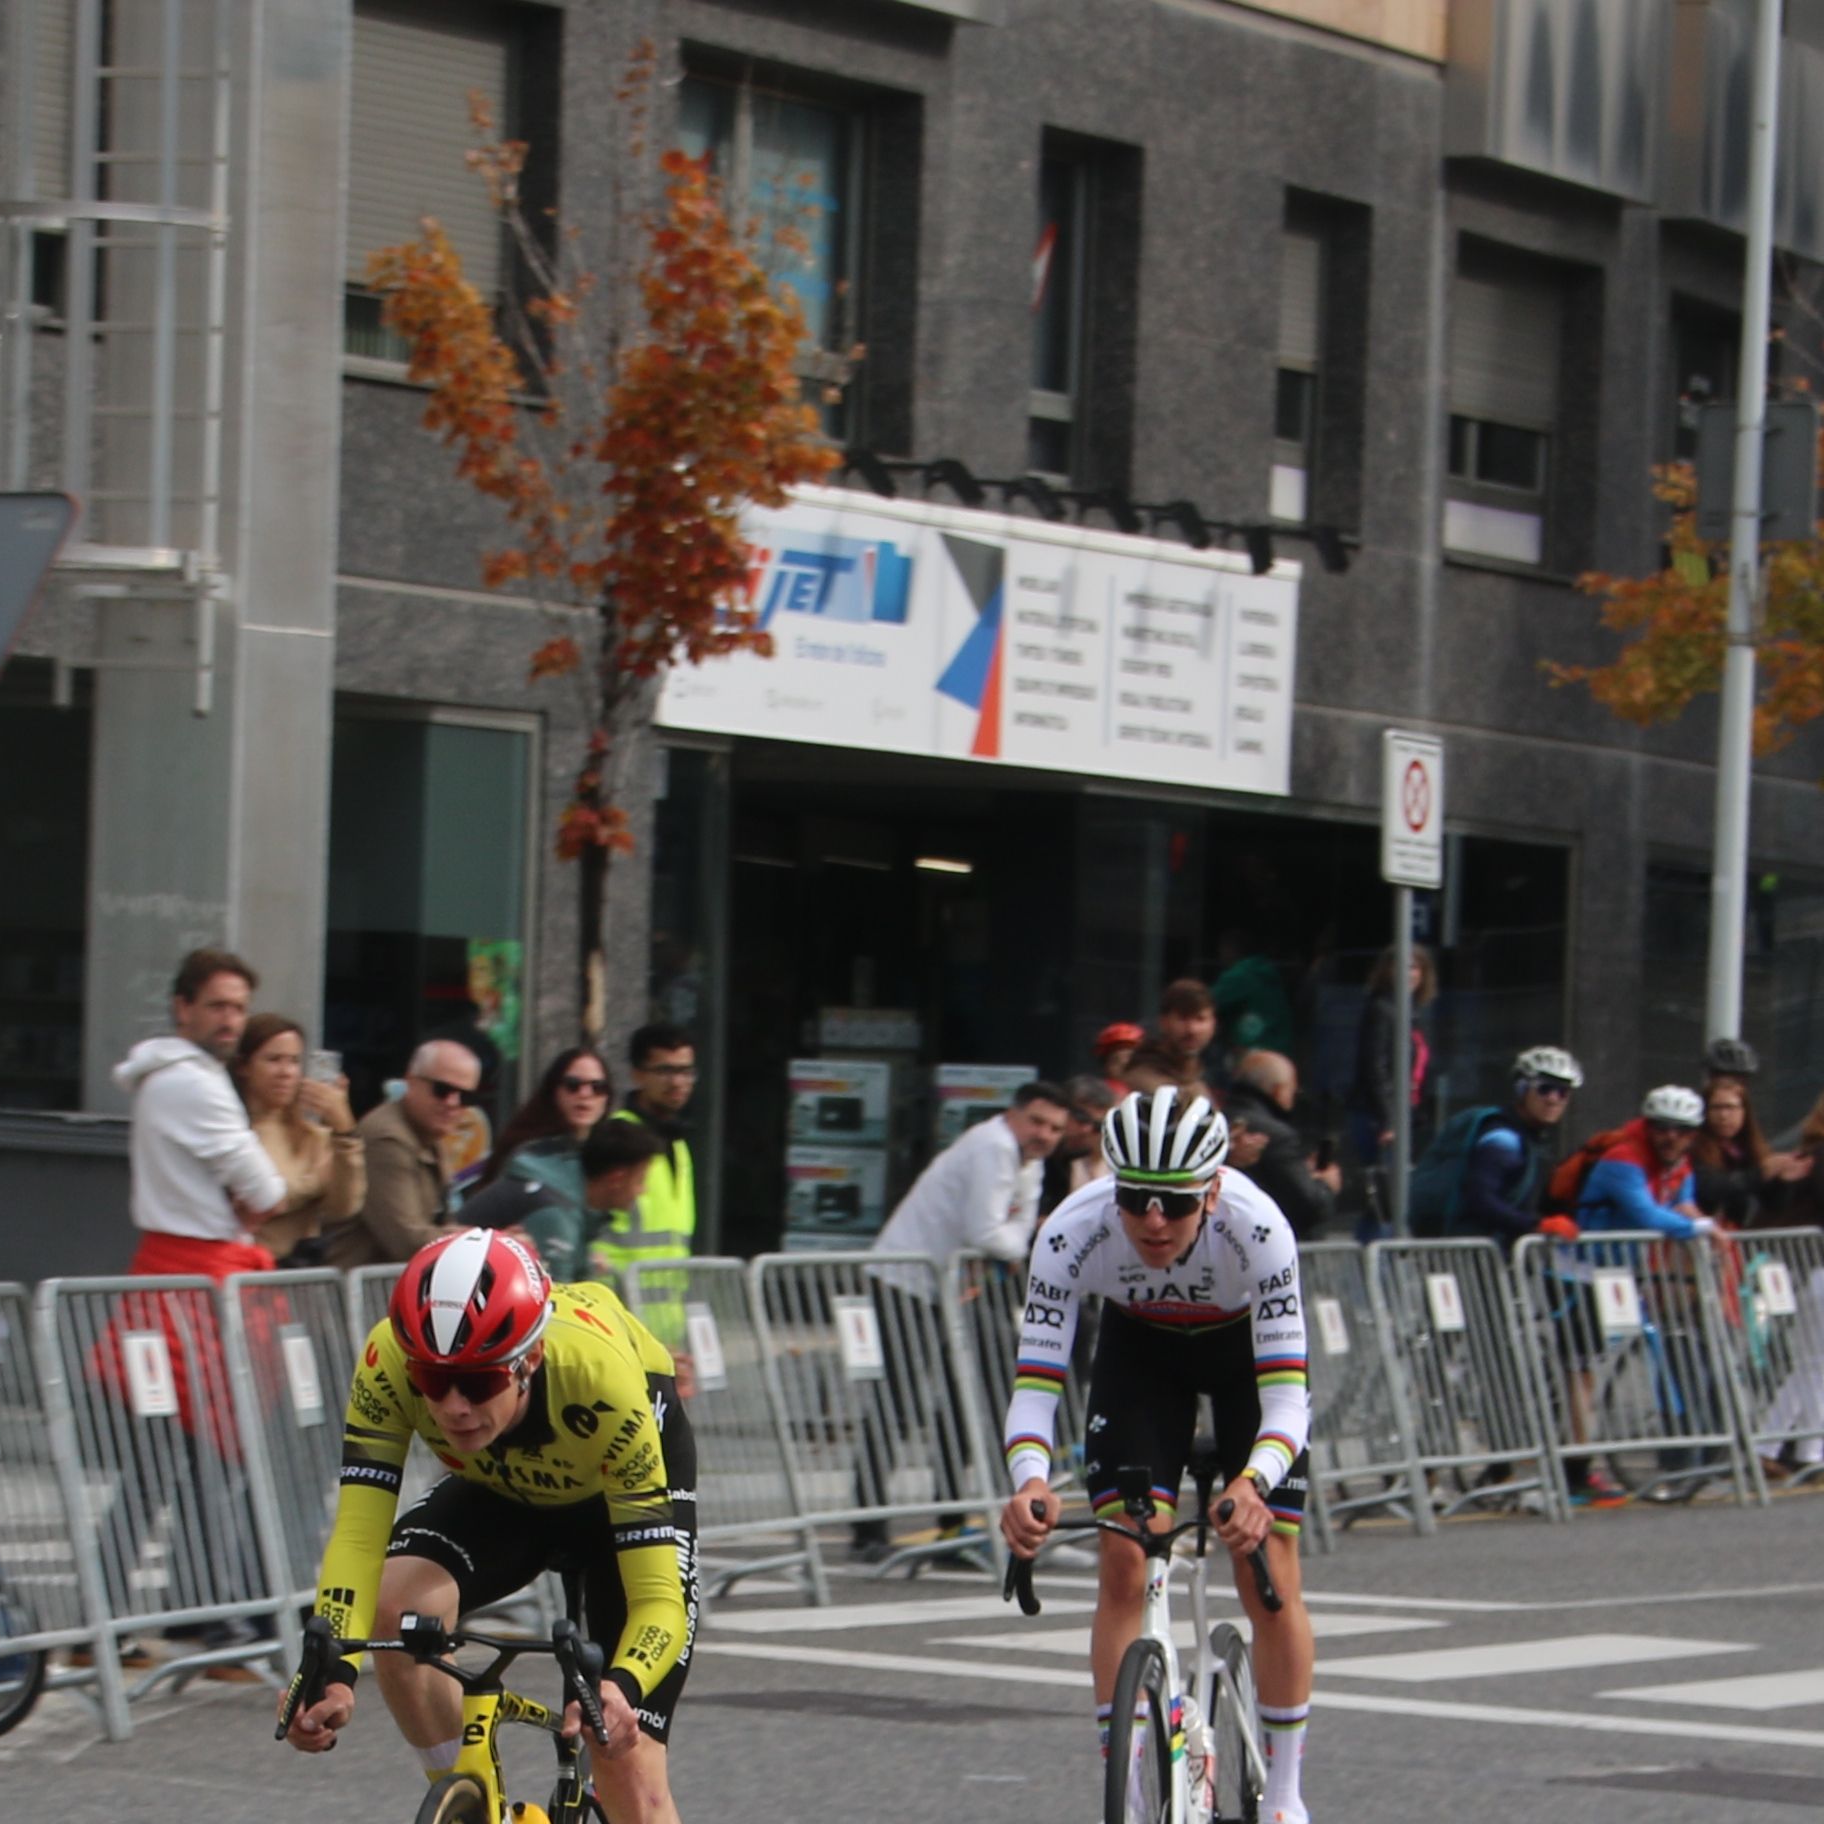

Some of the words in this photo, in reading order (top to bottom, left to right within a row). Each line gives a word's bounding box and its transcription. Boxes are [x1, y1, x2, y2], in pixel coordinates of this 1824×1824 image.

[1127, 1282, 1212, 1303] UAE
[604, 1408, 646, 1462] VISMA
[615, 1524, 675, 1544] SRAM
